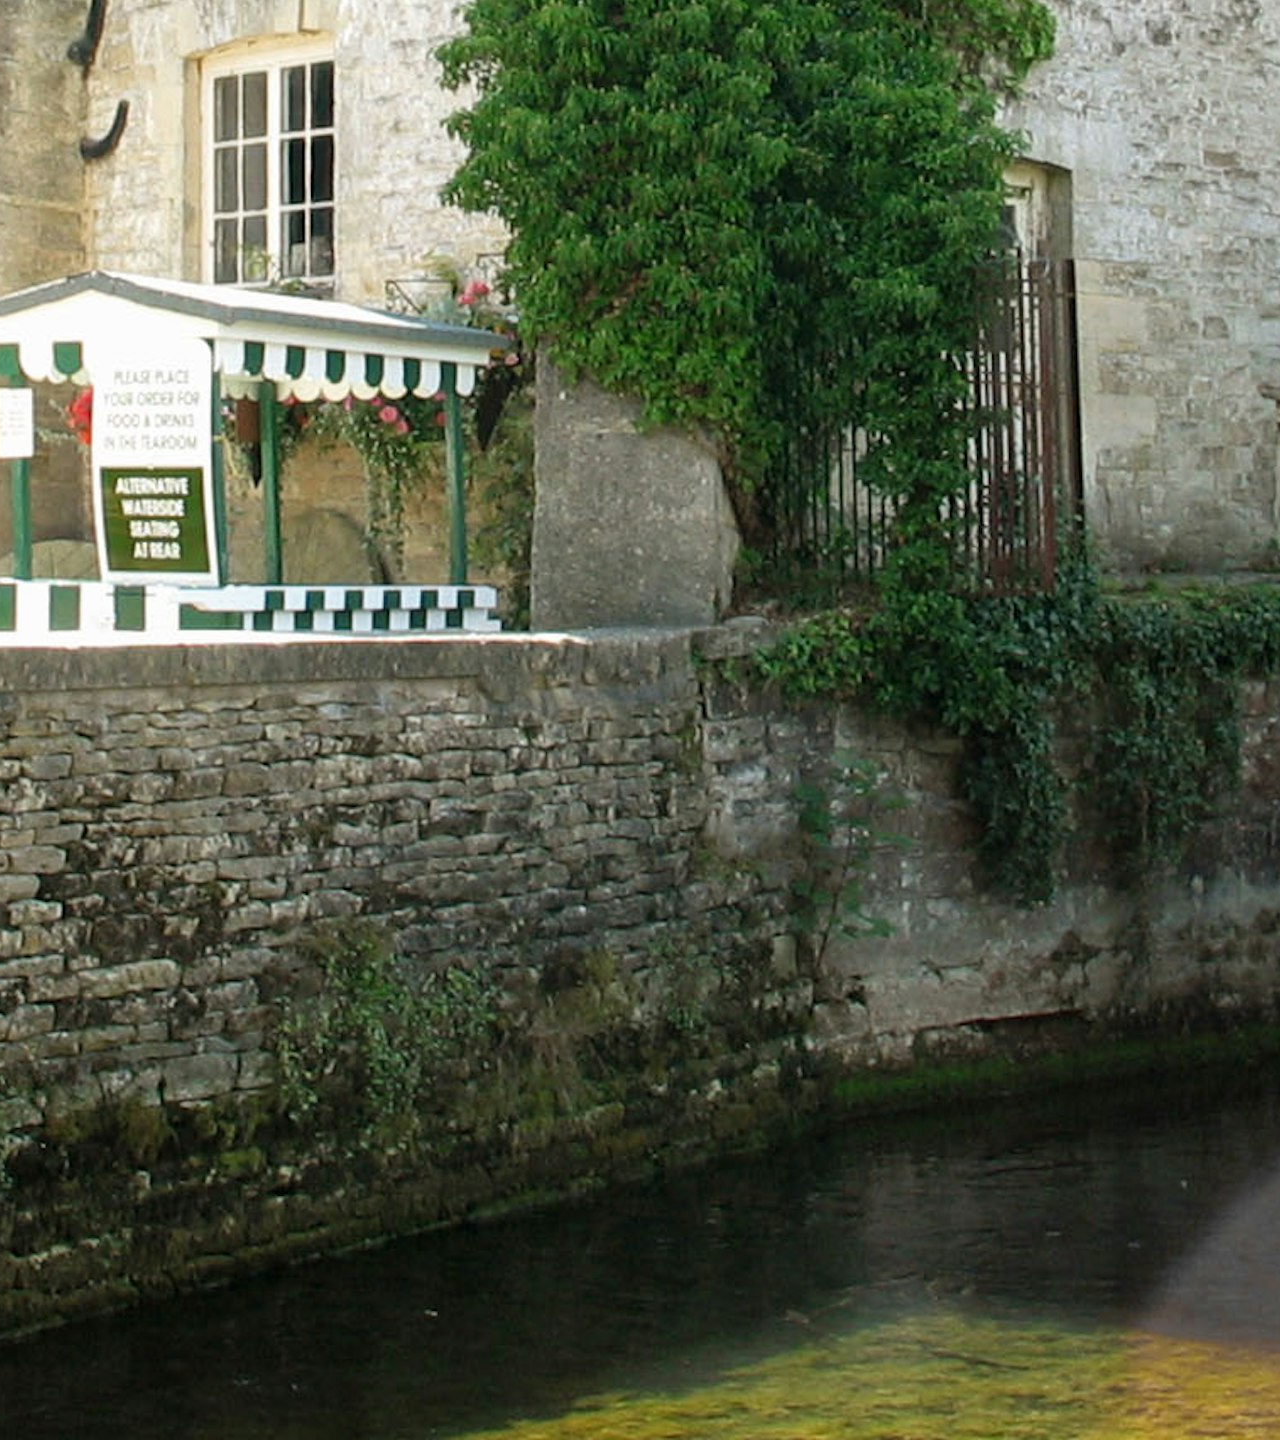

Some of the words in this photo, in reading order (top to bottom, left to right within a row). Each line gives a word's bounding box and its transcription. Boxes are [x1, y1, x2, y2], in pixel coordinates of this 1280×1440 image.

[114, 369, 151, 385] PLEASE
[154, 368, 189, 385] PLACE
[104, 391, 133, 407] YOUR
[137, 390, 174, 407] ORDER
[177, 390, 200, 406] FOR
[107, 413, 140, 428] FOOD
[154, 412, 194, 428] DRINKS
[119, 435, 136, 450] THE
[115, 476, 189, 495] ALTERNATIVE
[121, 498, 185, 516] WATERSIDE
[129, 520, 181, 538] SEATING
[133, 541, 148, 559] AT
[149, 541, 181, 559] REAR
